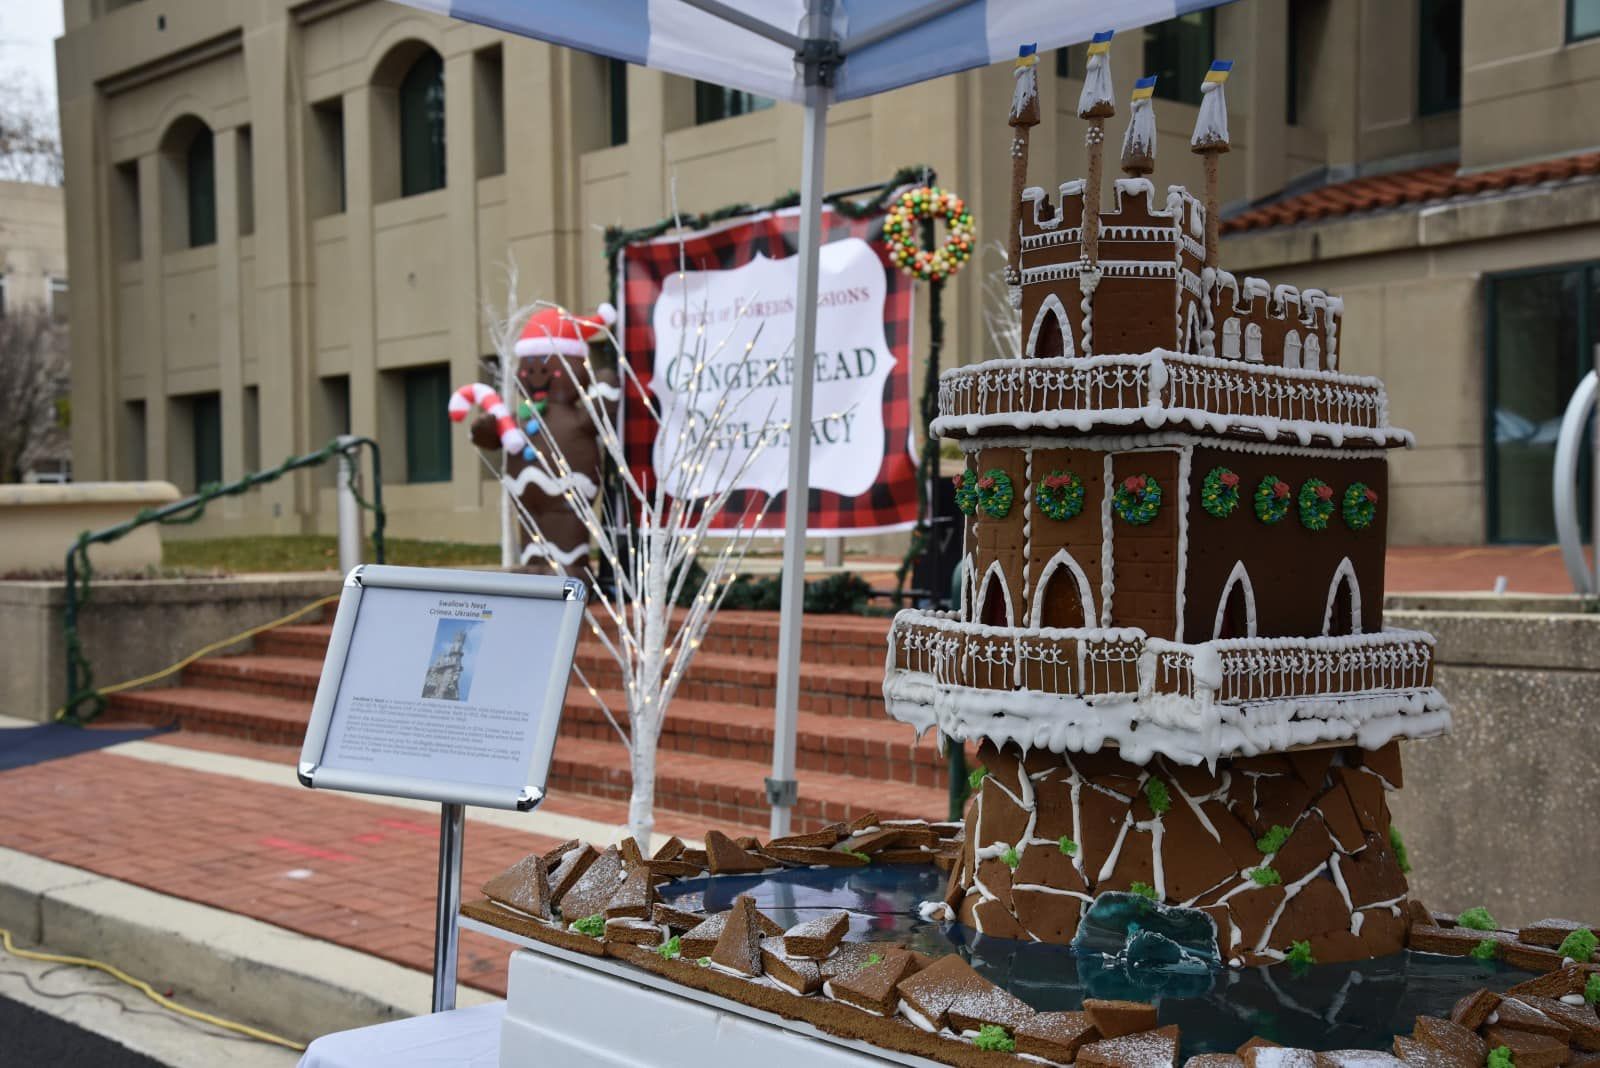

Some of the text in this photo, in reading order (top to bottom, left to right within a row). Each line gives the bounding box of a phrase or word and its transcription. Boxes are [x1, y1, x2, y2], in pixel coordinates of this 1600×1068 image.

[666, 347, 876, 393] GINGEREAD
[686, 409, 855, 451] DIPLOACY
[454, 609, 480, 618] Ukraine
